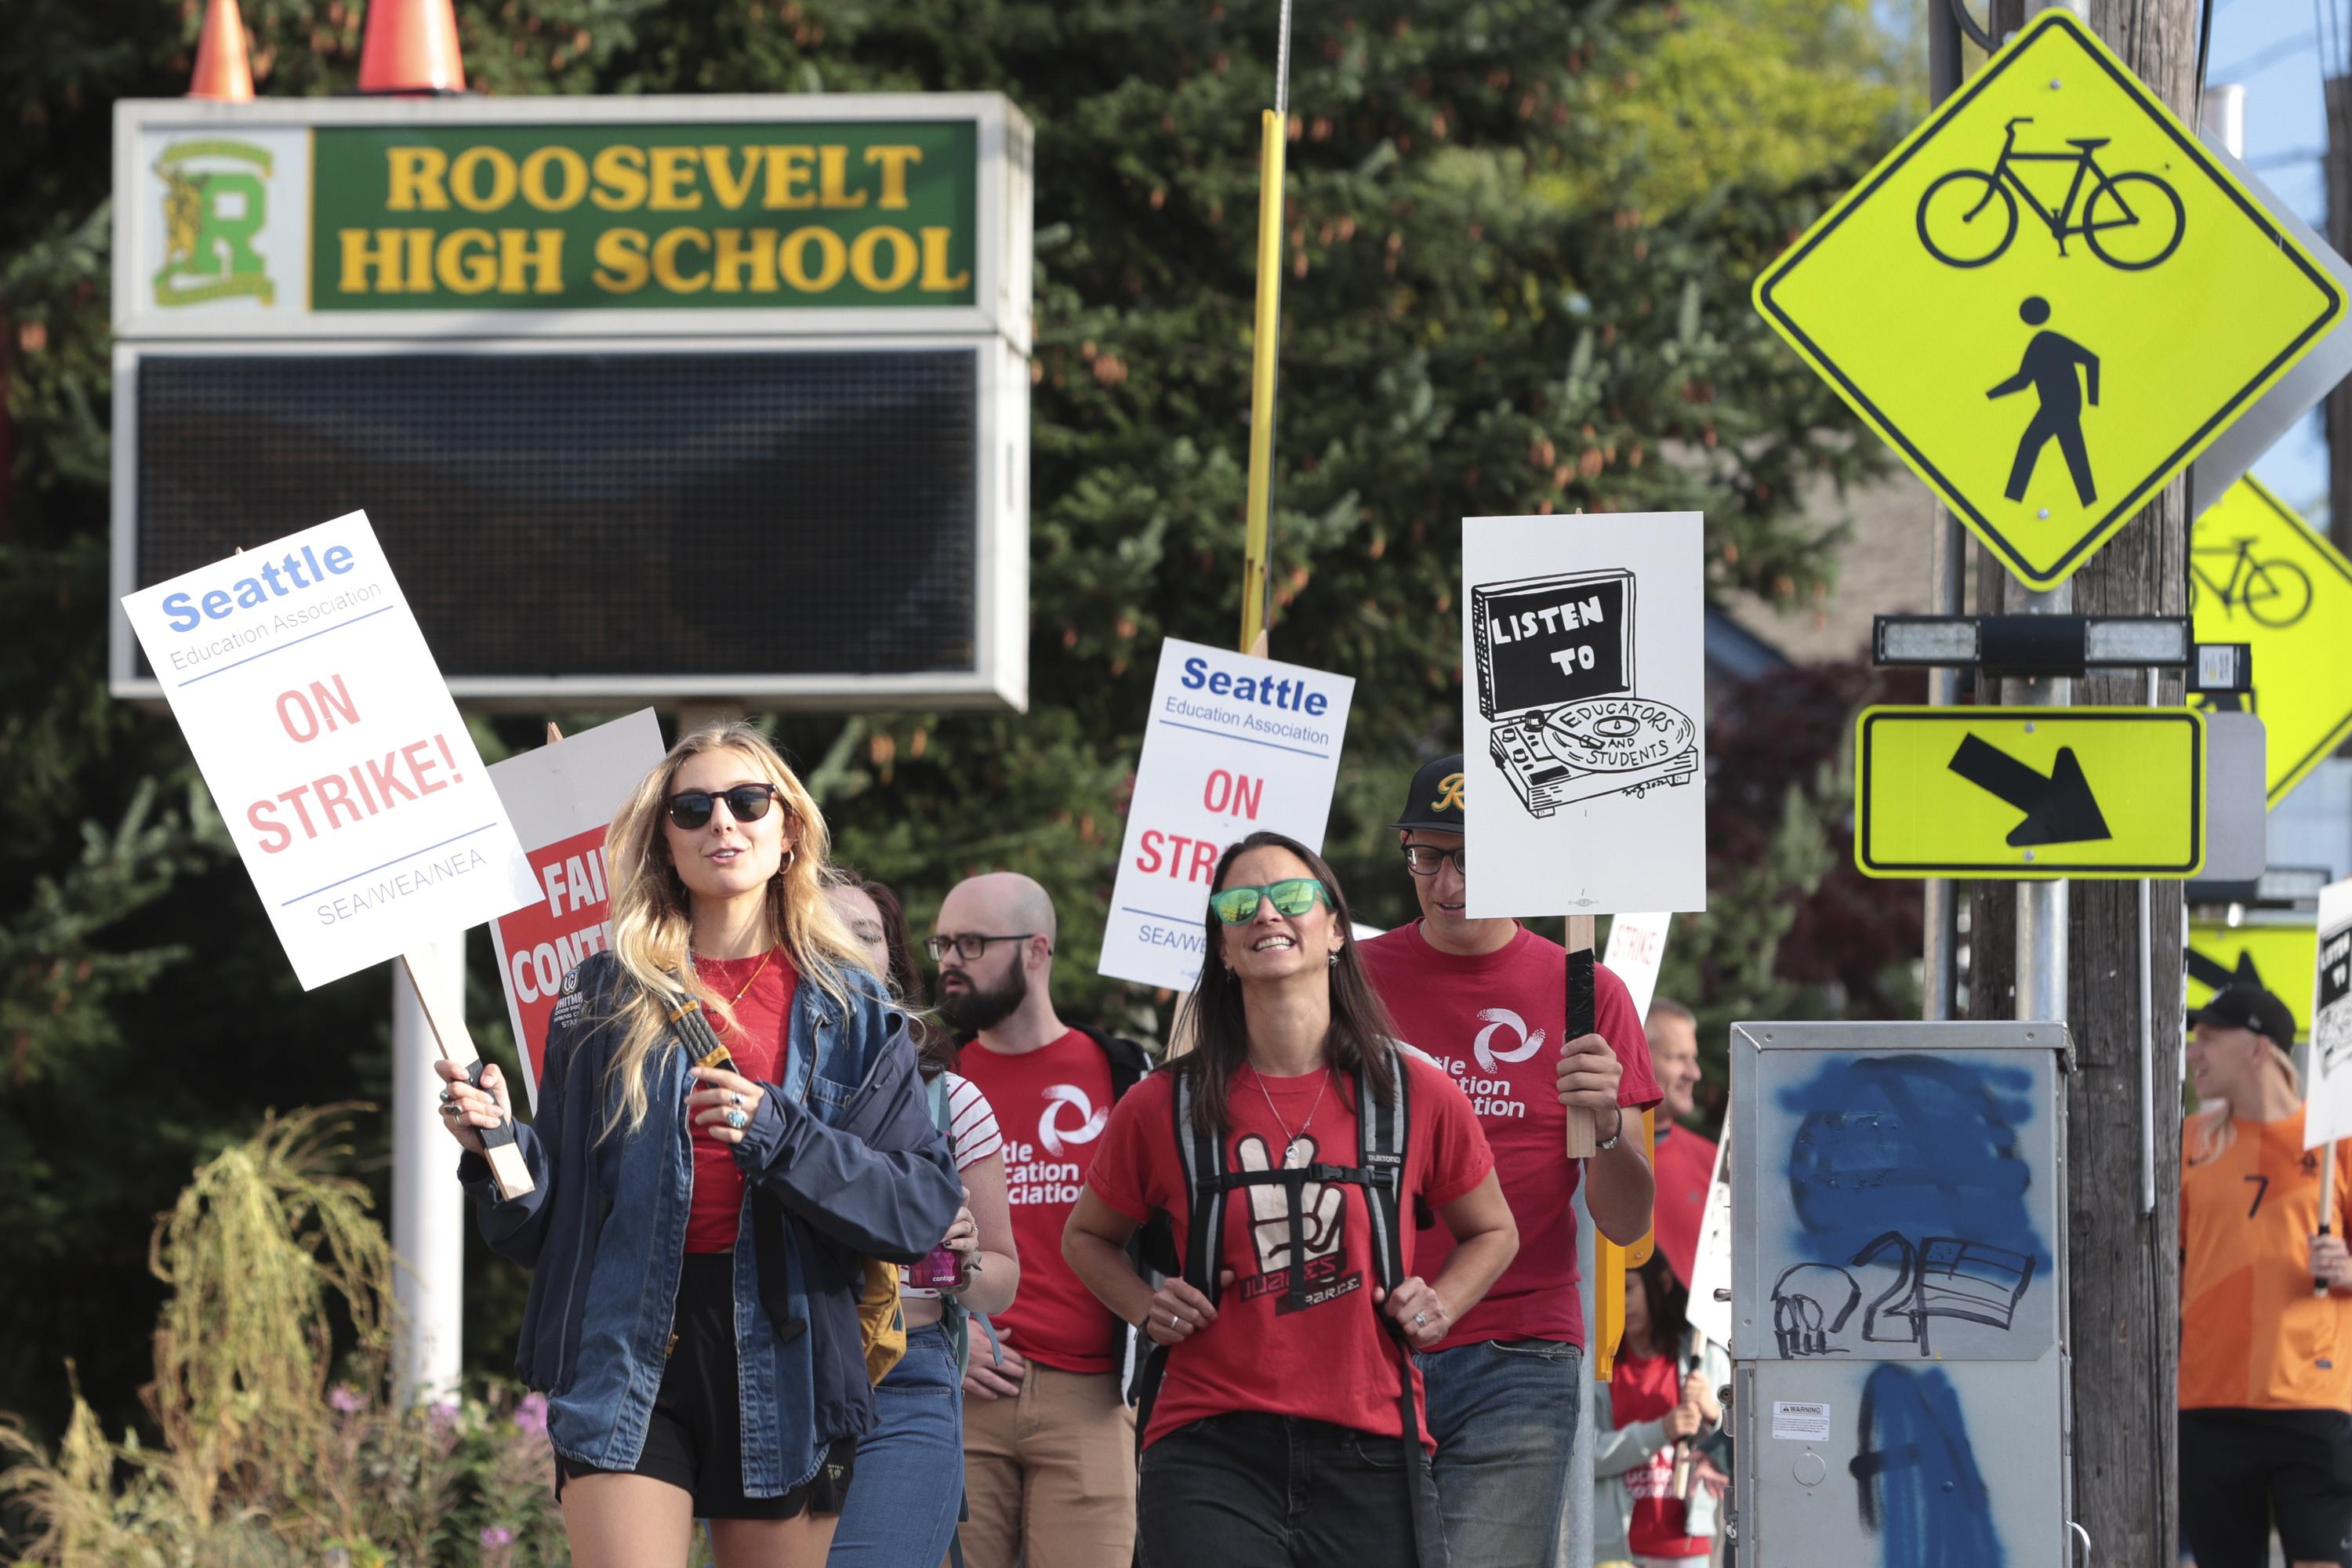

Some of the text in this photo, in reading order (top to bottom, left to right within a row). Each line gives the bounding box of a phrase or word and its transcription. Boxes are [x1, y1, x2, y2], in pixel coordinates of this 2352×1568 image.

[386, 145, 923, 212] ROOSEVELT
[339, 227, 565, 294] HIGH
[592, 225, 971, 293] SCHOOL
[162, 545, 355, 633] Seattle
[170, 583, 383, 670] Education Association
[1491, 595, 1604, 644] LISTEN
[1550, 645, 1595, 676] TO
[275, 674, 361, 743] ON
[1181, 656, 1329, 717] Seattle
[1165, 695, 1330, 746] Education Association
[1559, 702, 1675, 733] EDUCATORS
[1586, 739, 1669, 767] STUDENTS
[1607, 738, 1635, 749] AND
[246, 734, 464, 854] STRIKE!
[1203, 769, 1264, 821] ON
[1136, 829, 1225, 886] STR
[317, 848, 487, 926] SEA/WEA/NEA
[1455, 1075, 1511, 1096] tion
[1470, 1096, 1526, 1119] tion
[1001, 1141, 1034, 1164] tle
[1007, 1181, 1084, 1205] ciatio
[2244, 1175, 2269, 1220] 7
